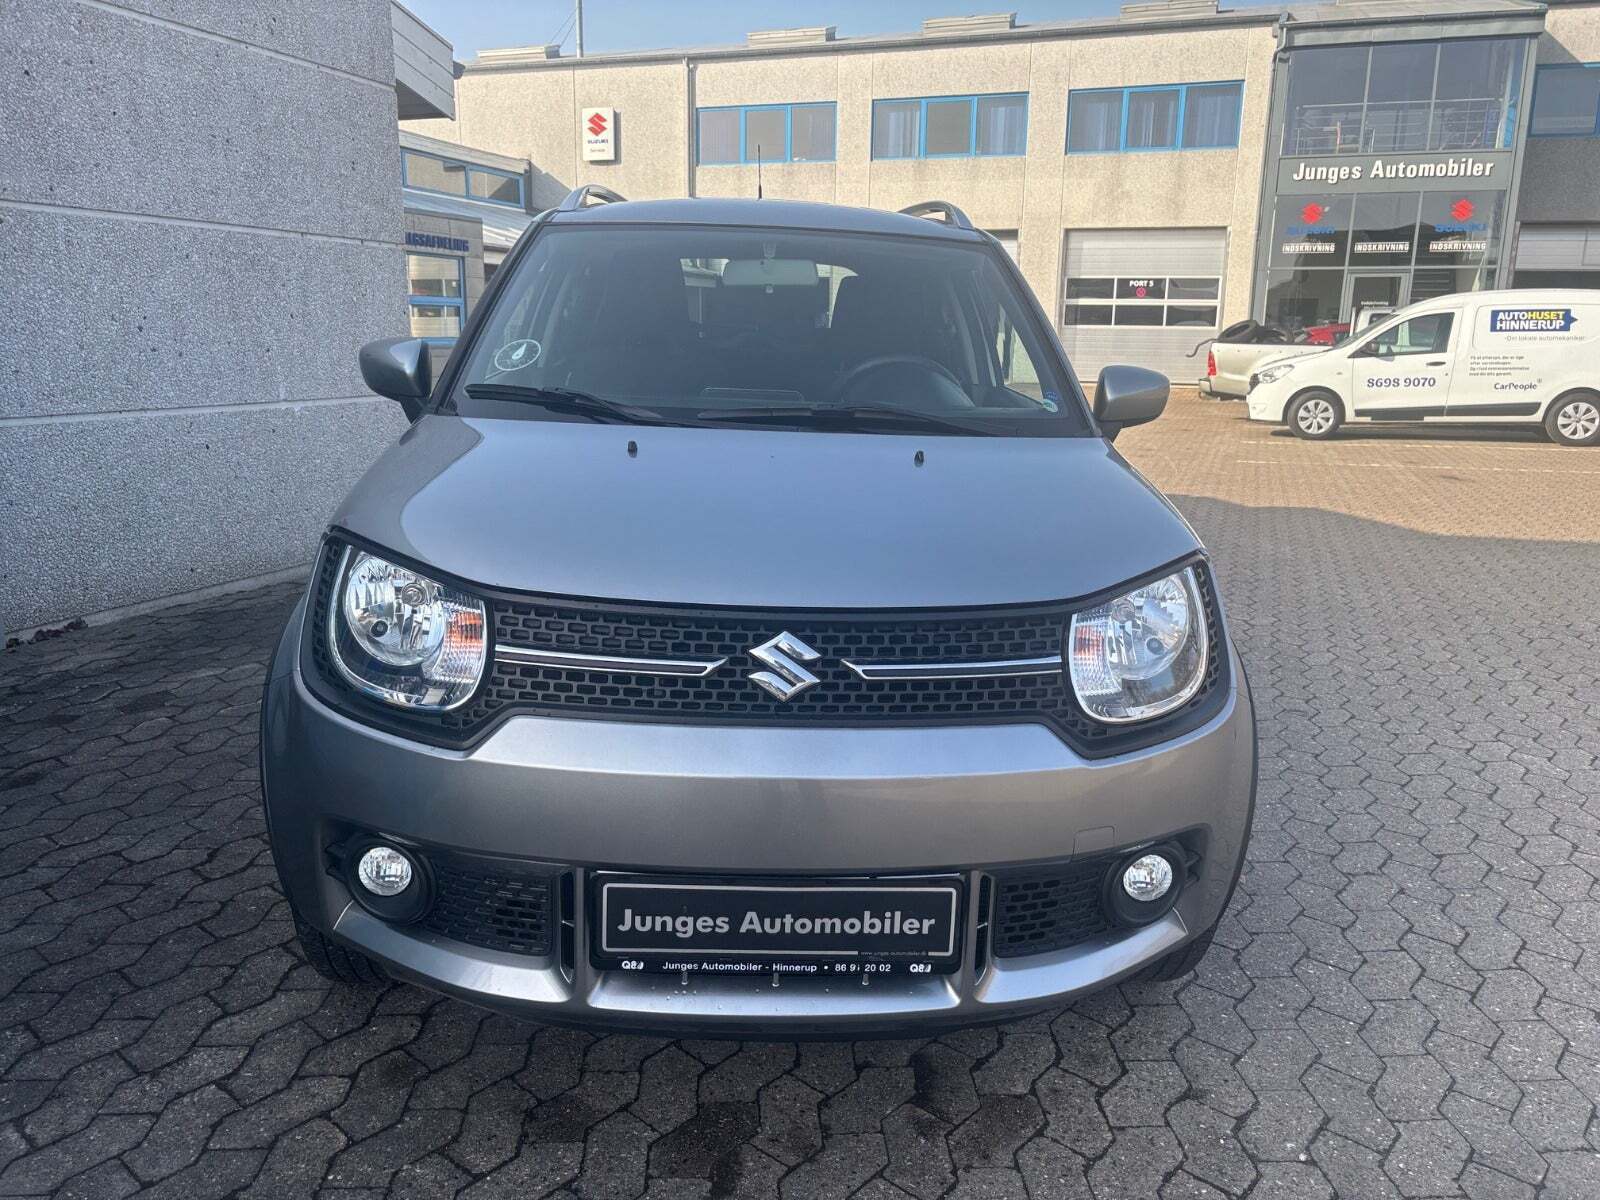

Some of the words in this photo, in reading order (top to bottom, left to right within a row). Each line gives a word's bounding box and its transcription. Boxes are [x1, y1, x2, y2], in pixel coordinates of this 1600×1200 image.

[1293, 163, 1362, 184] Junges
[1370, 158, 1495, 179] Automobiler
[1282, 243, 1335, 252] INDSKRIVNING
[1354, 243, 1410, 252] INDSKRIVNING
[1429, 242, 1487, 251] INDSKRIVNING
[1497, 311, 1564, 320] AUTOHUSET
[1496, 320, 1564, 330] HINNERUP
[1367, 378, 1400, 387] 8698
[1403, 377, 1436, 387] 9070
[617, 908, 730, 938] Junges
[739, 910, 936, 935] Automobiler
[662, 961, 699, 972] Junges
[701, 961, 762, 971] Automobiler
[772, 963, 817, 973] Hinnerup
[834, 963, 847, 972] 86
[864, 963, 876, 972] 20
[879, 963, 891, 972] 02
